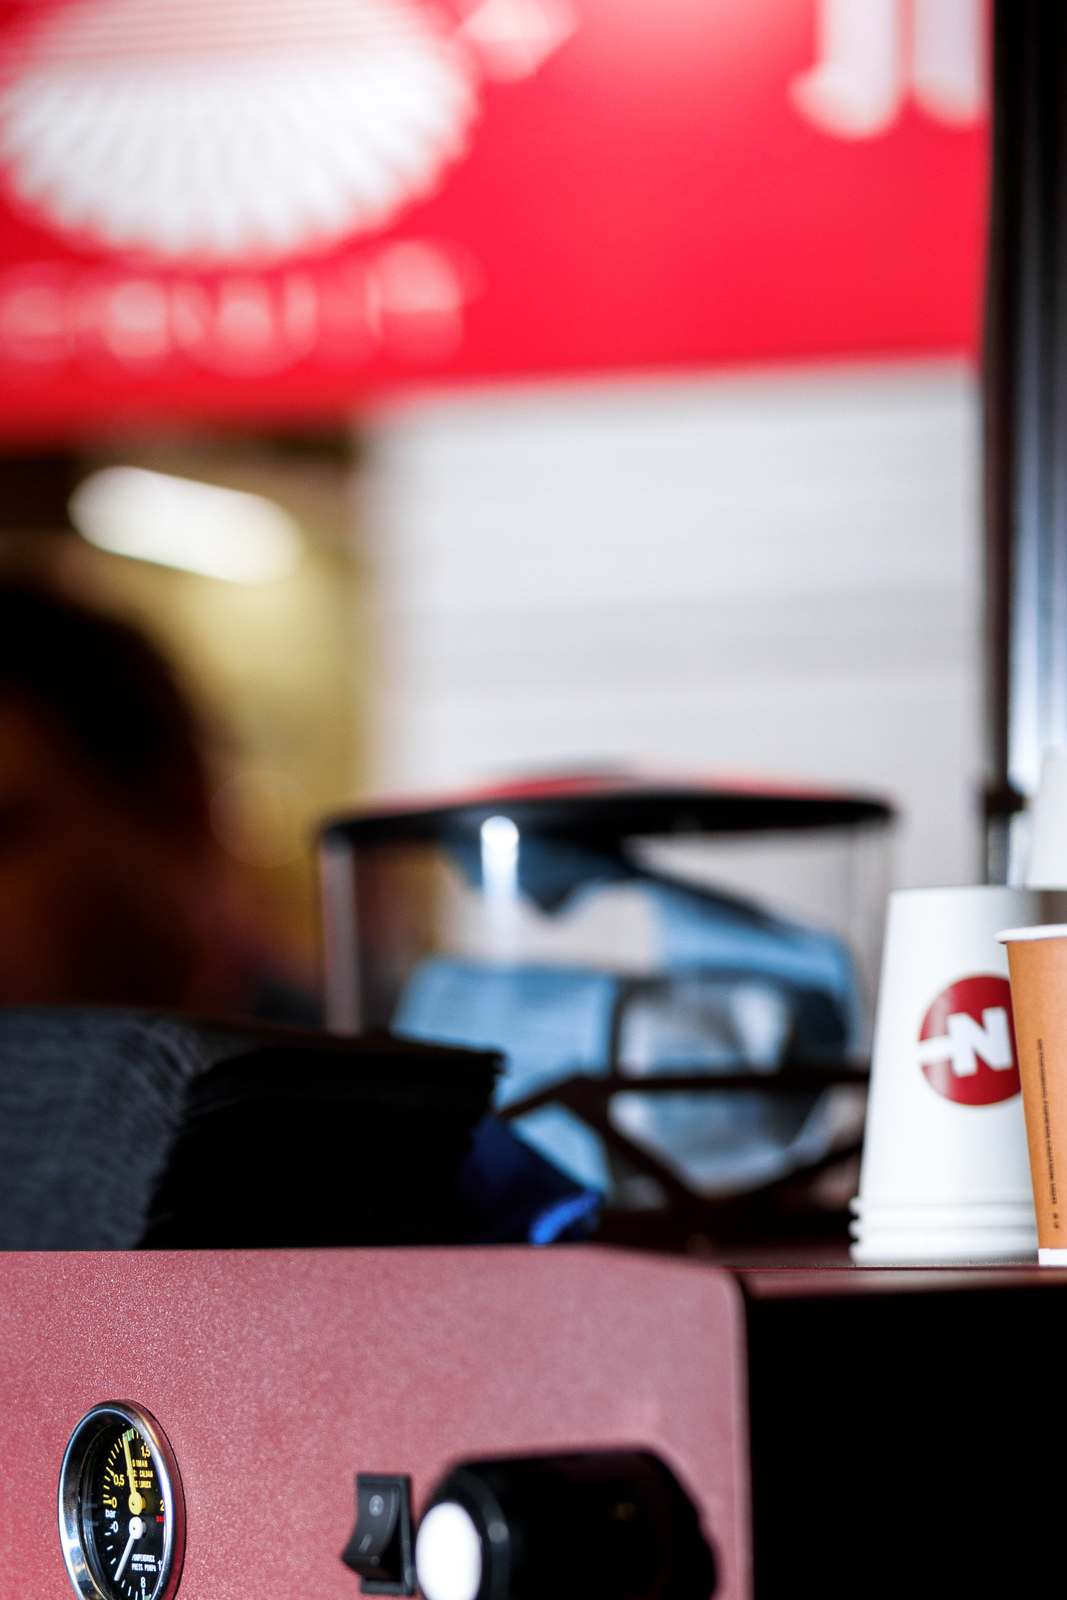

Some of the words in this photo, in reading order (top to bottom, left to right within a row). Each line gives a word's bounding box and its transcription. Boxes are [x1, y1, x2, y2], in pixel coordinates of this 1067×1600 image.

[113, 1474, 125, 1487] 0,5
[105, 1508, 116, 1518] bar
[140, 1576, 146, 1588] 8
